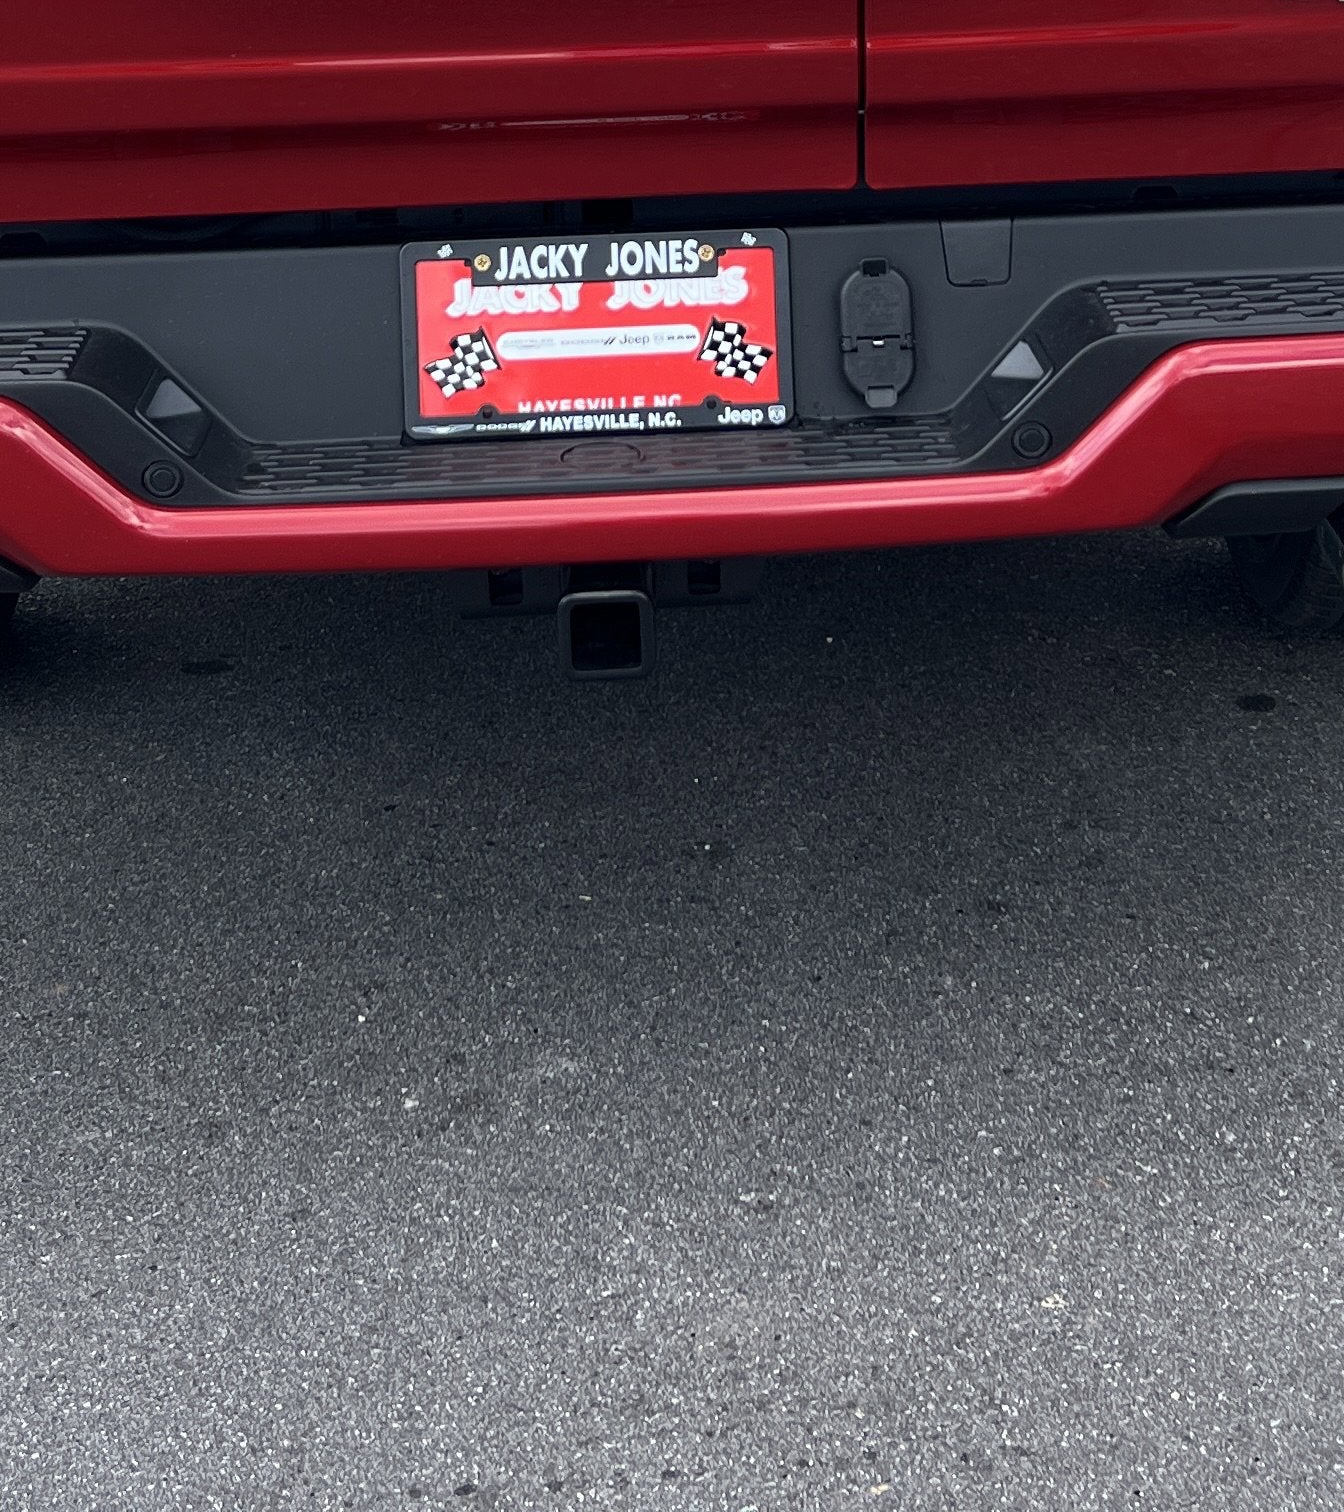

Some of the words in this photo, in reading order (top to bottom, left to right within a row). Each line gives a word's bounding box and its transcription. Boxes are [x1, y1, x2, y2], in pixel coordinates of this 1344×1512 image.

[494, 244, 589, 281] JACKY
[606, 239, 700, 276] JONES
[446, 278, 584, 317] JACKY
[606, 266, 749, 309] JONES
[619, 334, 650, 346] Jeep
[540, 412, 645, 431] HAYESVILLE,
[648, 411, 682, 428] N.C.
[718, 406, 764, 425] Jeep
